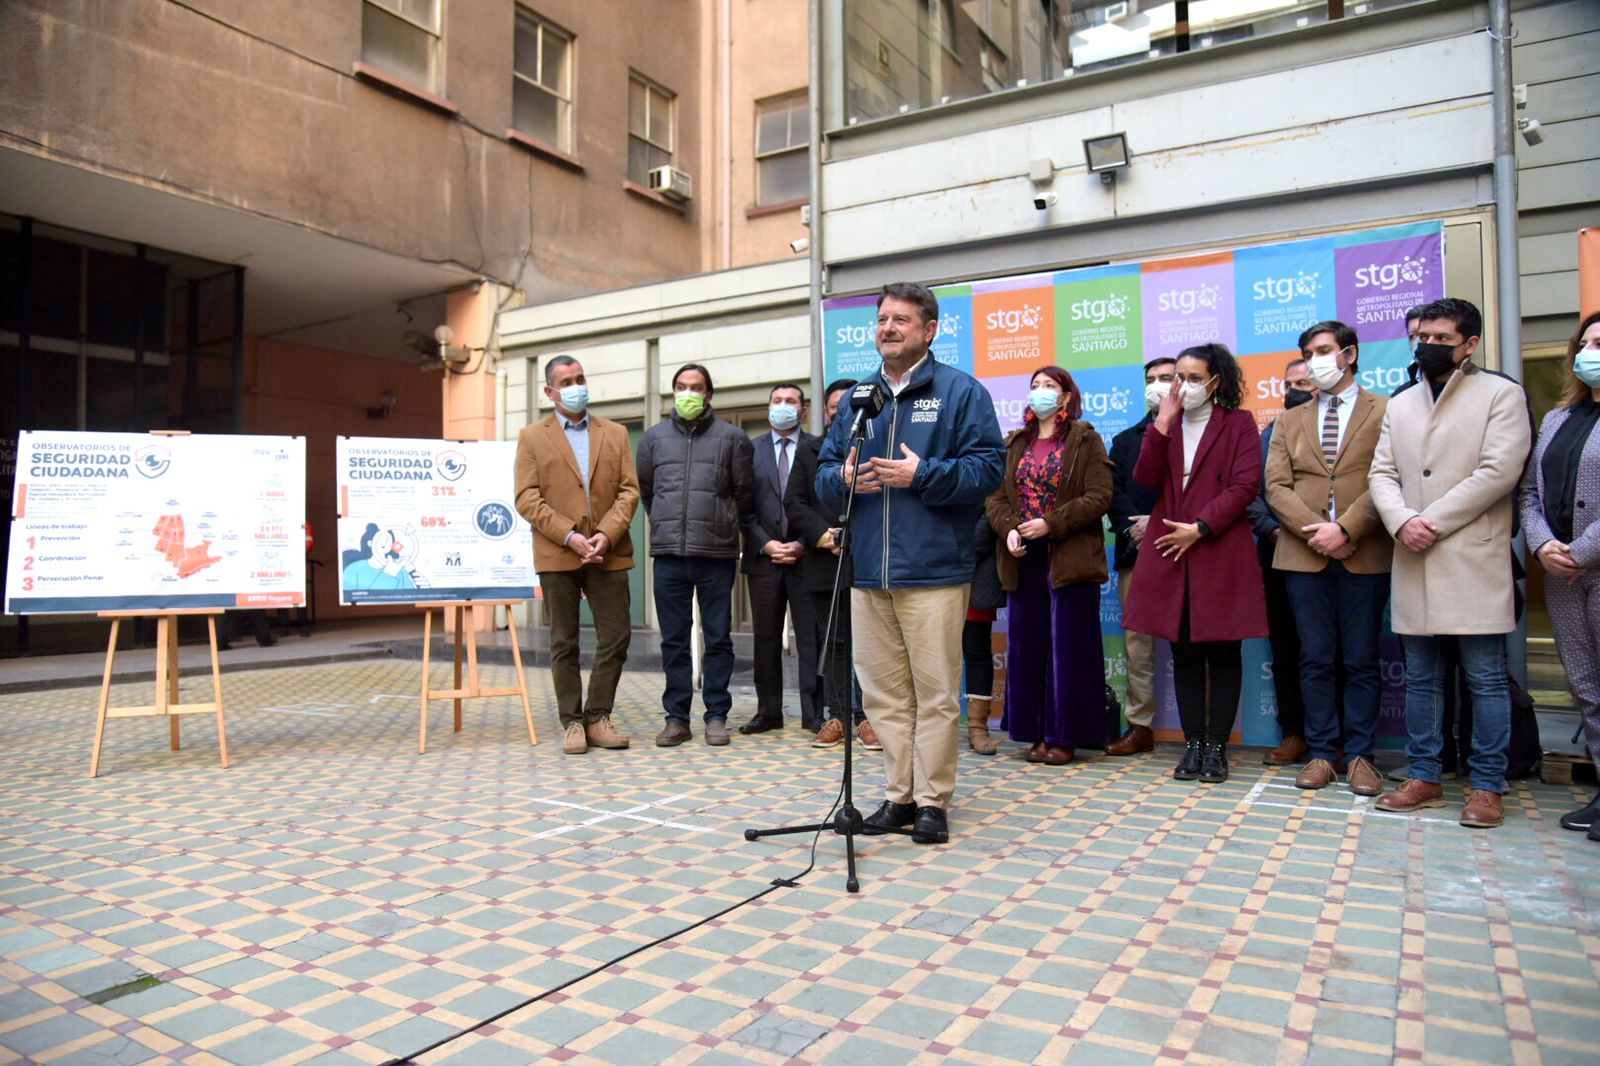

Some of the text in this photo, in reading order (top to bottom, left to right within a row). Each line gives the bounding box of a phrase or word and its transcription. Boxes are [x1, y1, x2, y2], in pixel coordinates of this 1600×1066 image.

[1356, 291, 1424, 305] GOBIERNO REGIONAL
[1254, 304, 1316, 317] GOBIERNO REGIONAL
[1356, 298, 1424, 312] METROPOLITANO DE
[1254, 312, 1308, 323] METROPOLITANO
[1356, 307, 1412, 324] SANTIA
[1254, 319, 1319, 336] SANTIAGO
[1159, 330, 1219, 345] SANTIAGO
[1071, 338, 1127, 353] SANTIAGO
[987, 348, 1040, 361] SANTIAGO
[32, 442, 131, 452] OBSERVATORIOS DE
[348, 448, 419, 456] OBSERVATORIOS
[31, 453, 131, 465] SEGURIDAD
[349, 457, 433, 468] SEGURIDAD
[30, 466, 129, 478] CIUDADANA
[349, 469, 433, 481] CIUDADANA
[432, 486, 456, 496] 31%
[26, 536, 36, 549] 1
[23, 556, 35, 571] 2
[22, 576, 34, 591] 3
